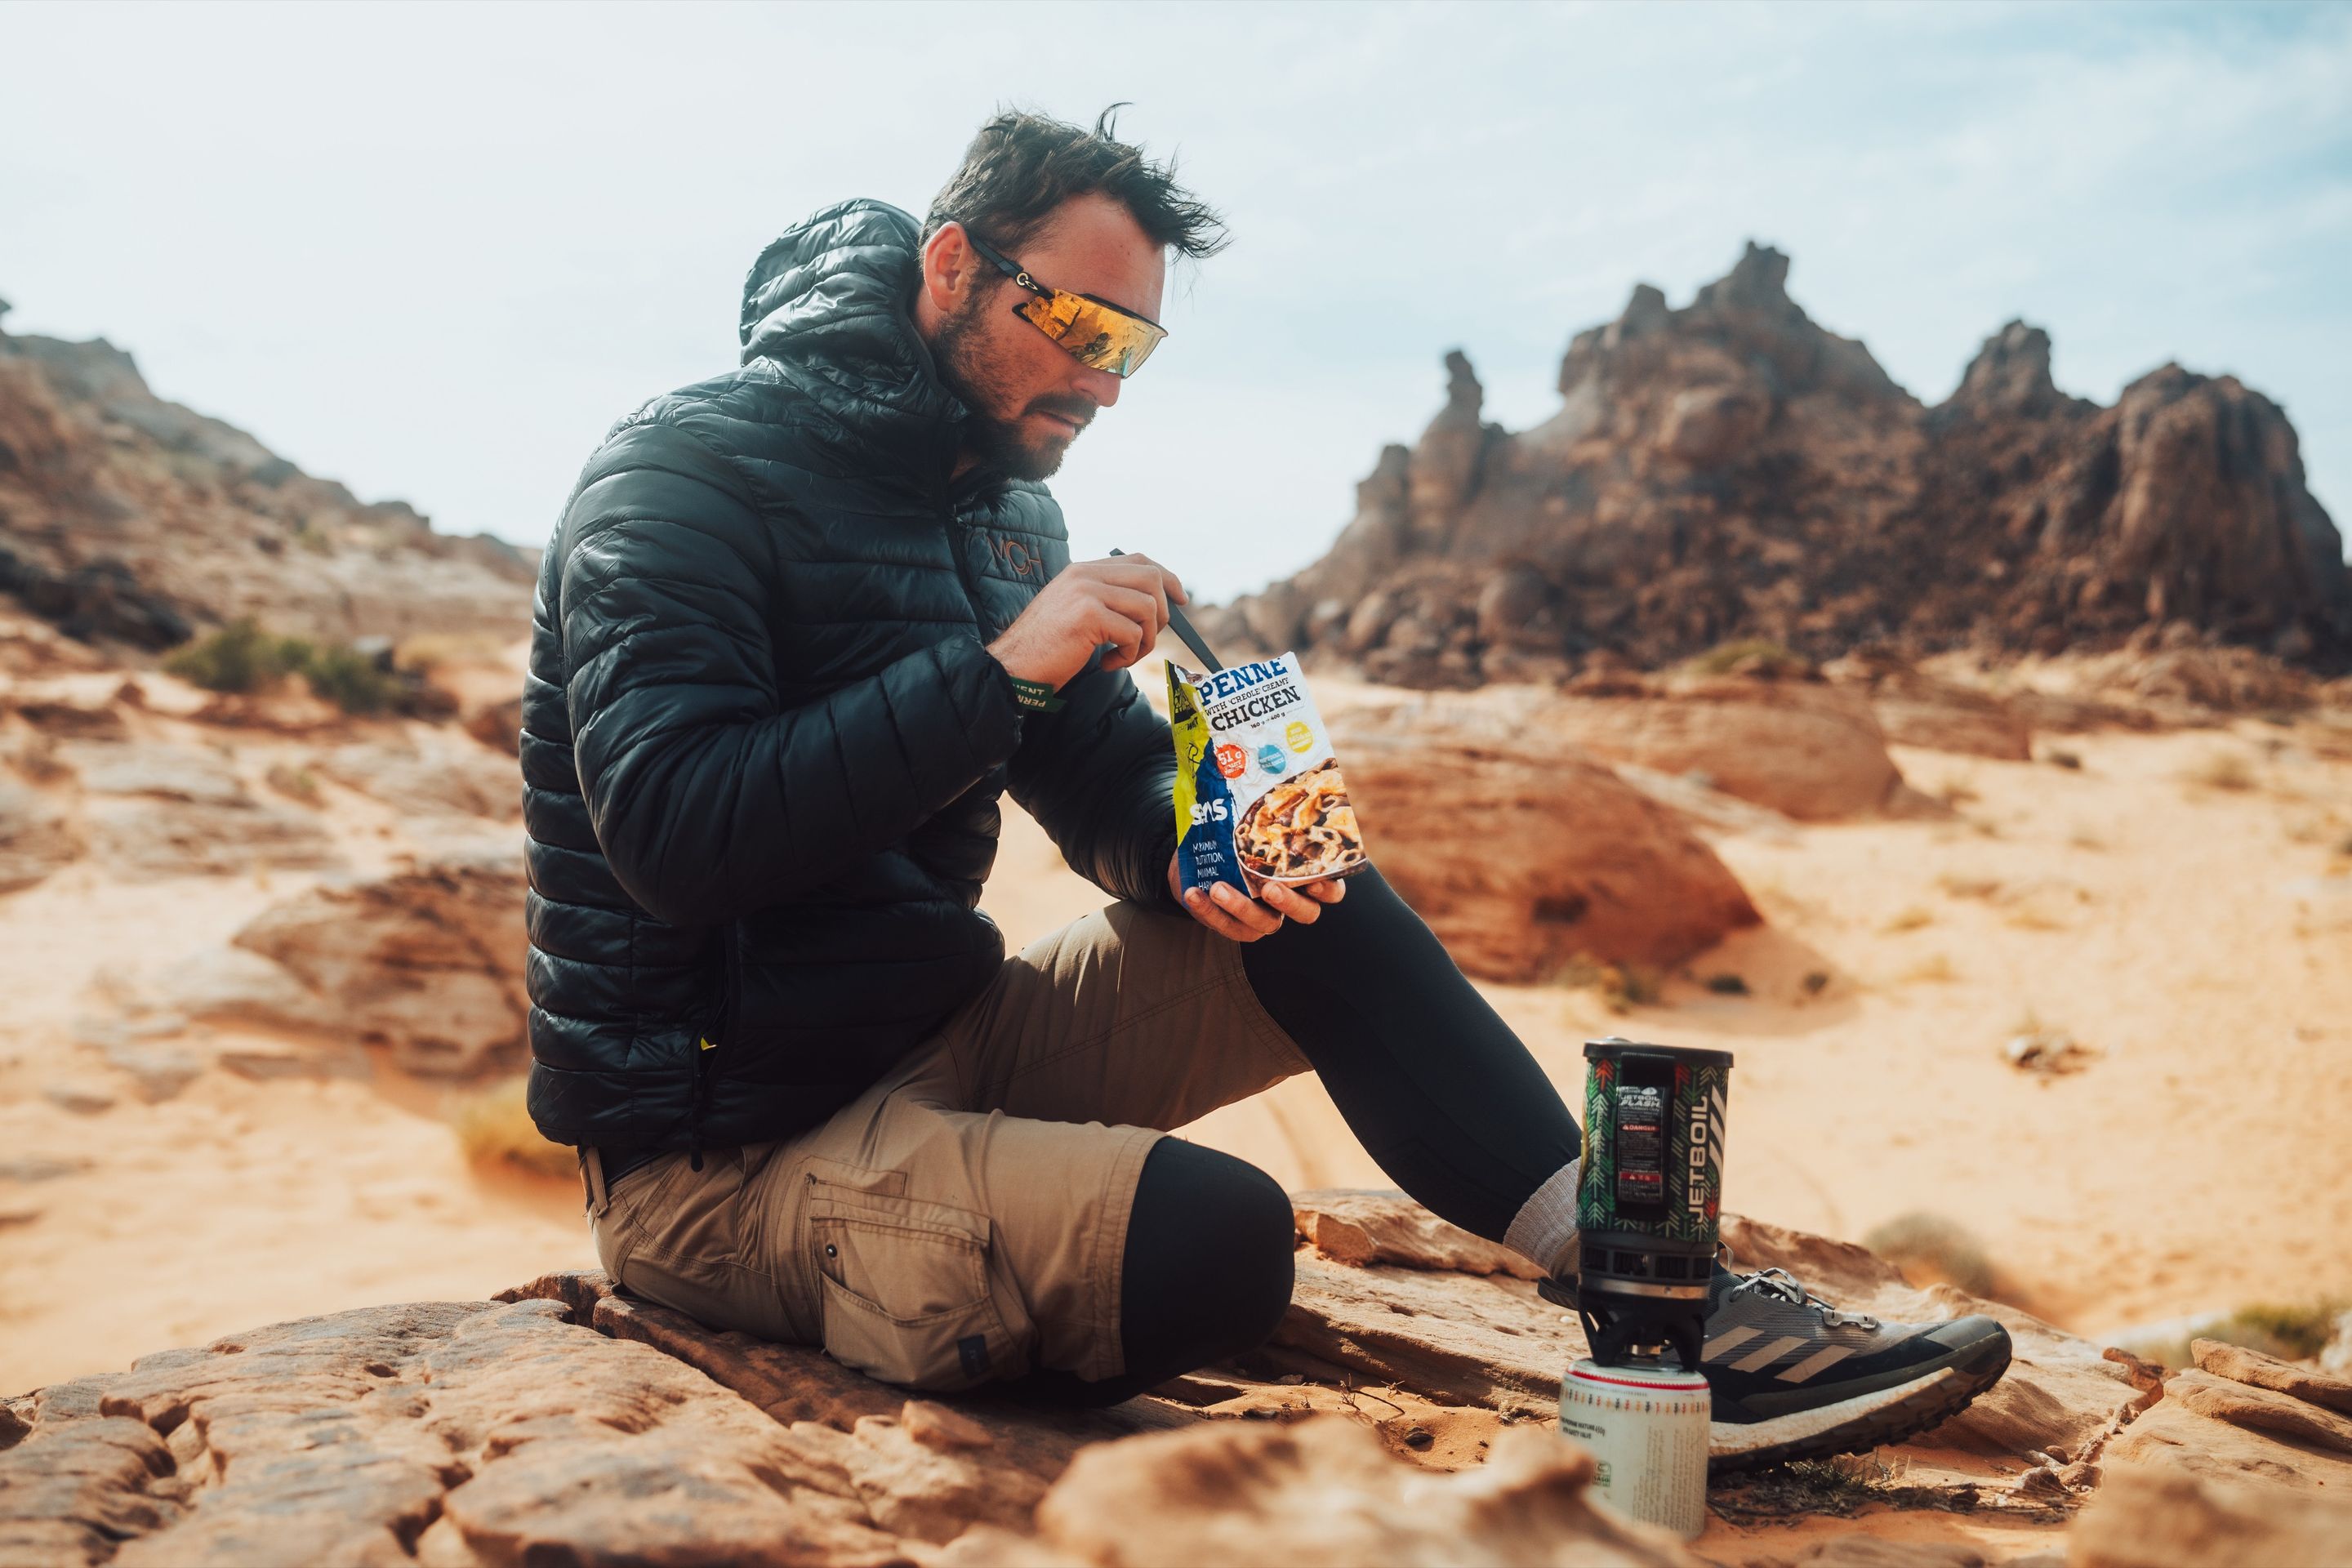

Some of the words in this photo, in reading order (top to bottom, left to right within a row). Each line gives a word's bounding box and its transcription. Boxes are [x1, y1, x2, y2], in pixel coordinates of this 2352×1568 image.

[1196, 657, 1288, 706] PENNE
[1205, 701, 1227, 717] WITH
[1262, 677, 1289, 693] CREAMY
[1211, 685, 1301, 731] CHICKEN
[1218, 750, 1233, 766] 51
[1619, 1100, 1660, 1108] FLASH
[1688, 1095, 1708, 1223] JETBOIL
